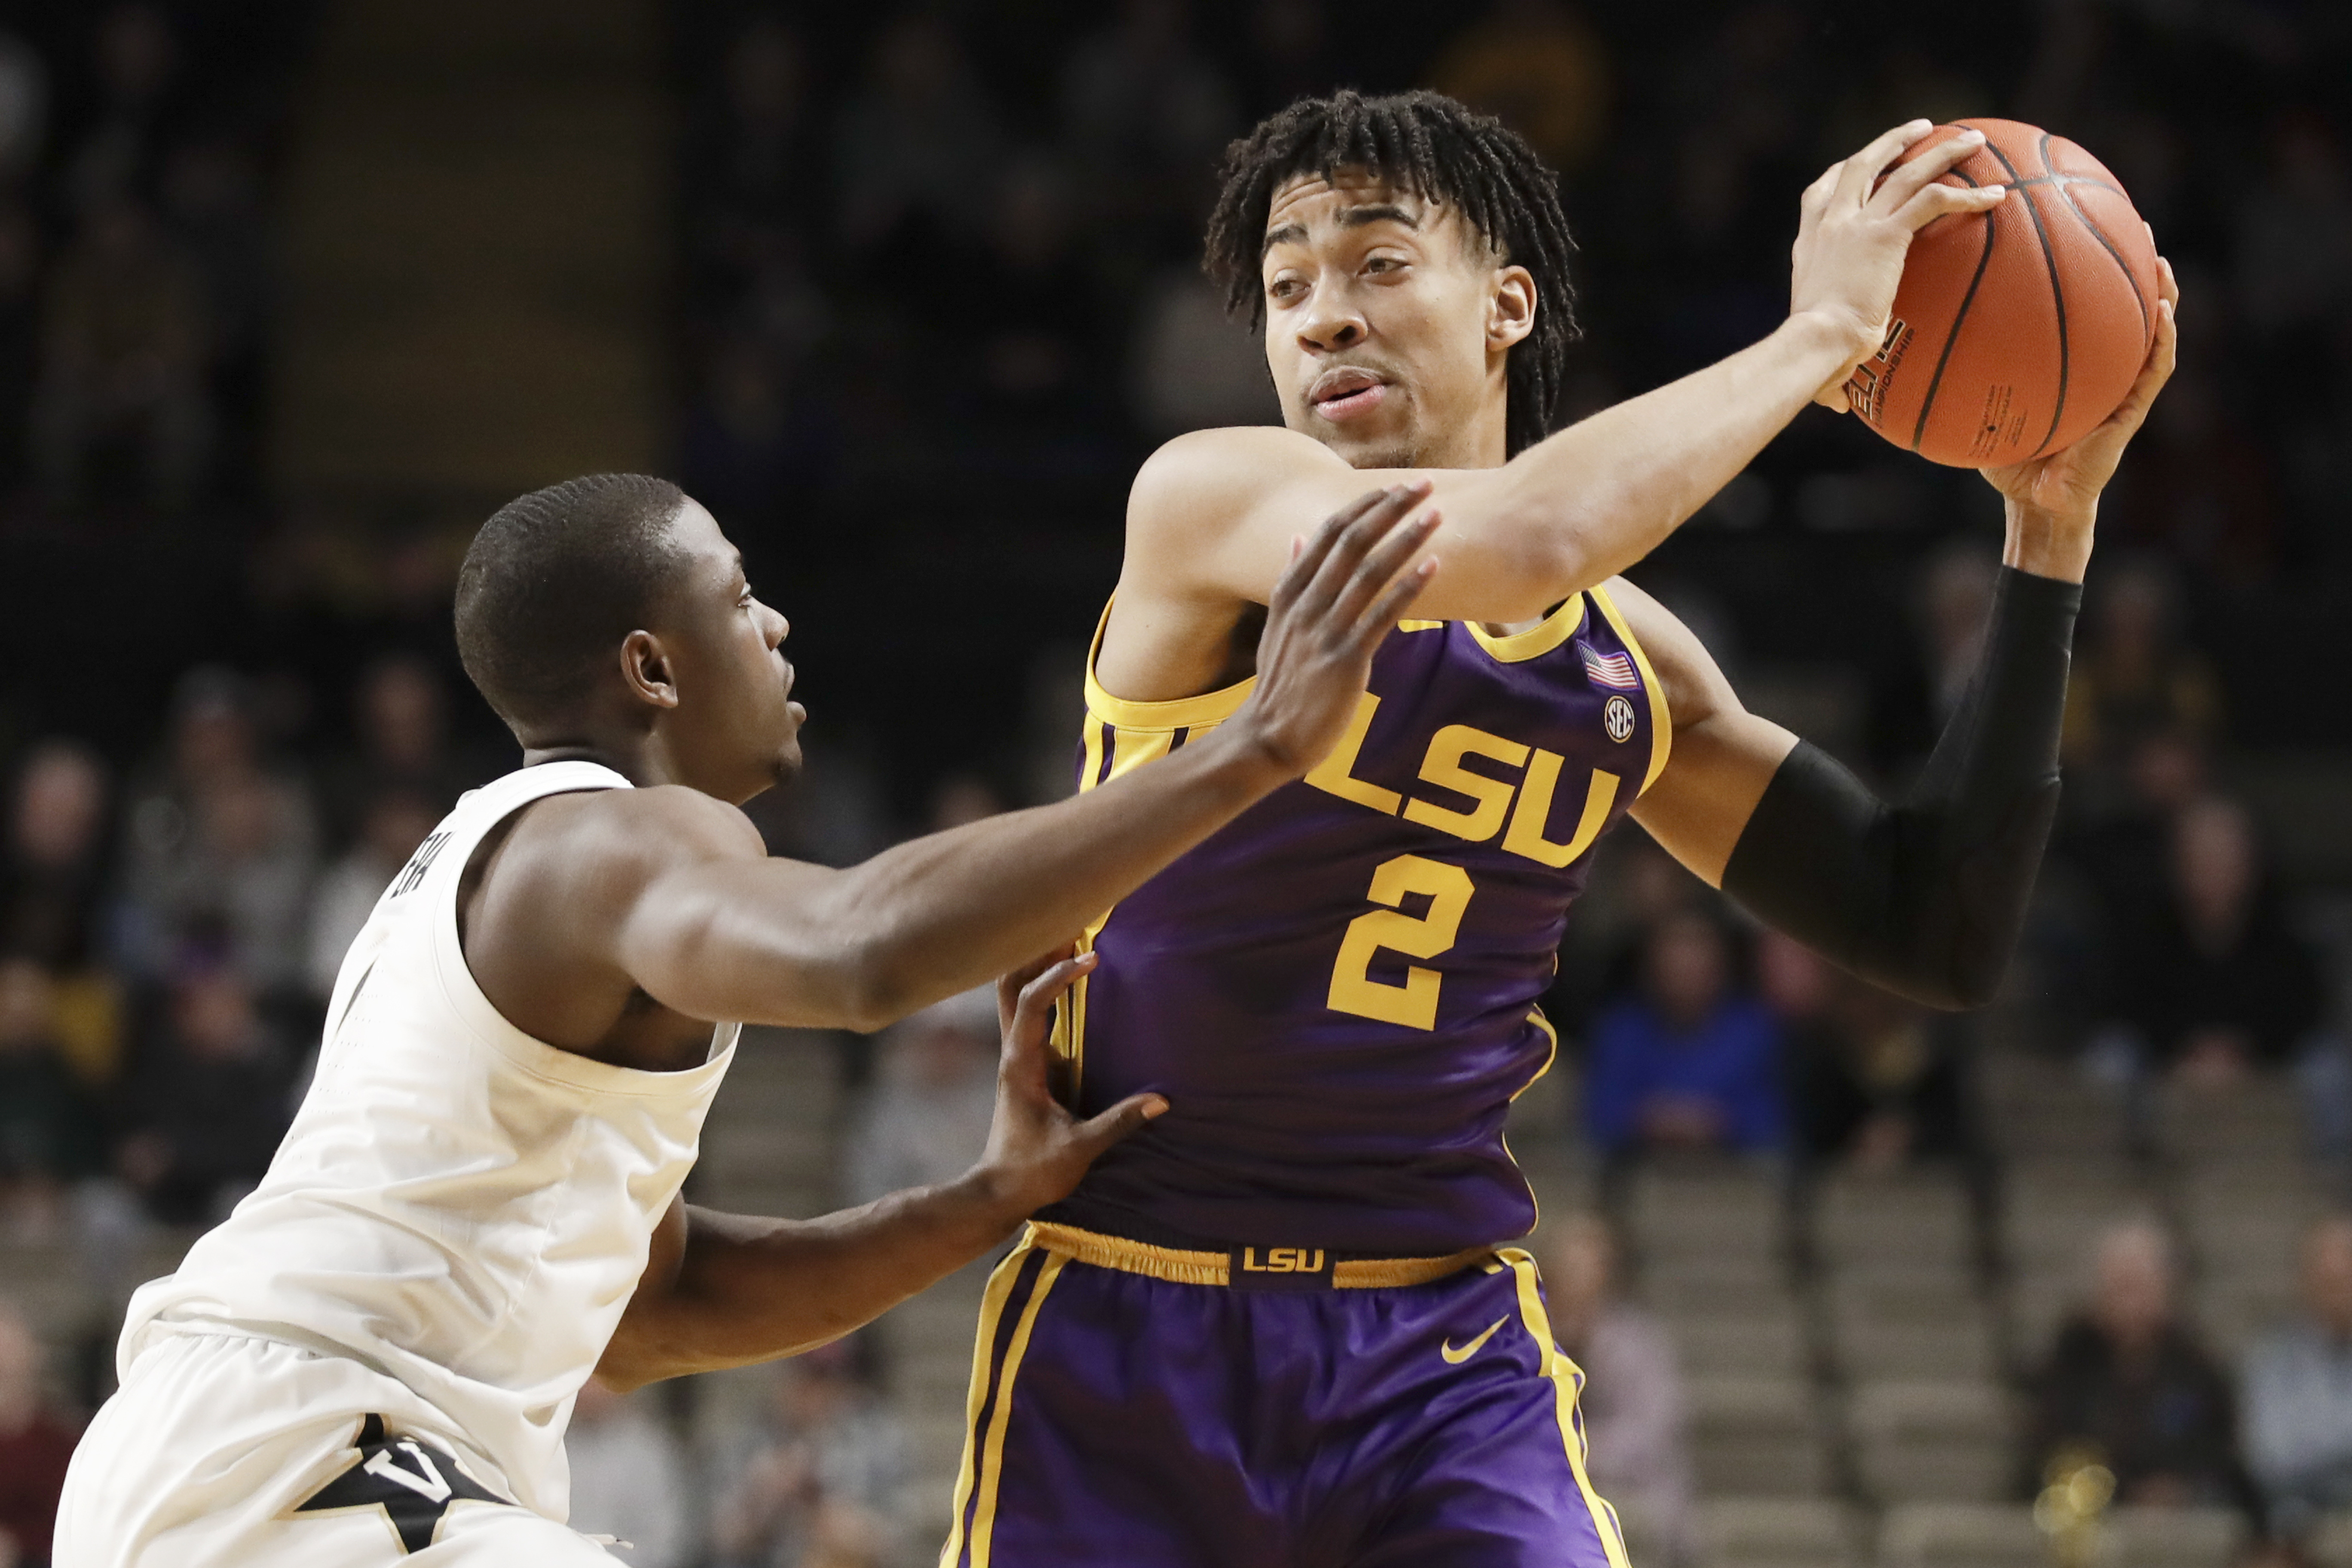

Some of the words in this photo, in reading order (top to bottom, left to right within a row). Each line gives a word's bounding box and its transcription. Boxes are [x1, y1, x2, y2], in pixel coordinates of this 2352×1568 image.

[1843, 319, 1906, 420] ELI
[1875, 328, 1915, 429] AMPIONSHIP
[1608, 699, 1632, 738] SEC
[1304, 691, 1620, 868] LSU
[1326, 854, 1475, 1032] 2
[1243, 1246, 1324, 1273] LSU
[363, 1442, 453, 1504] V
